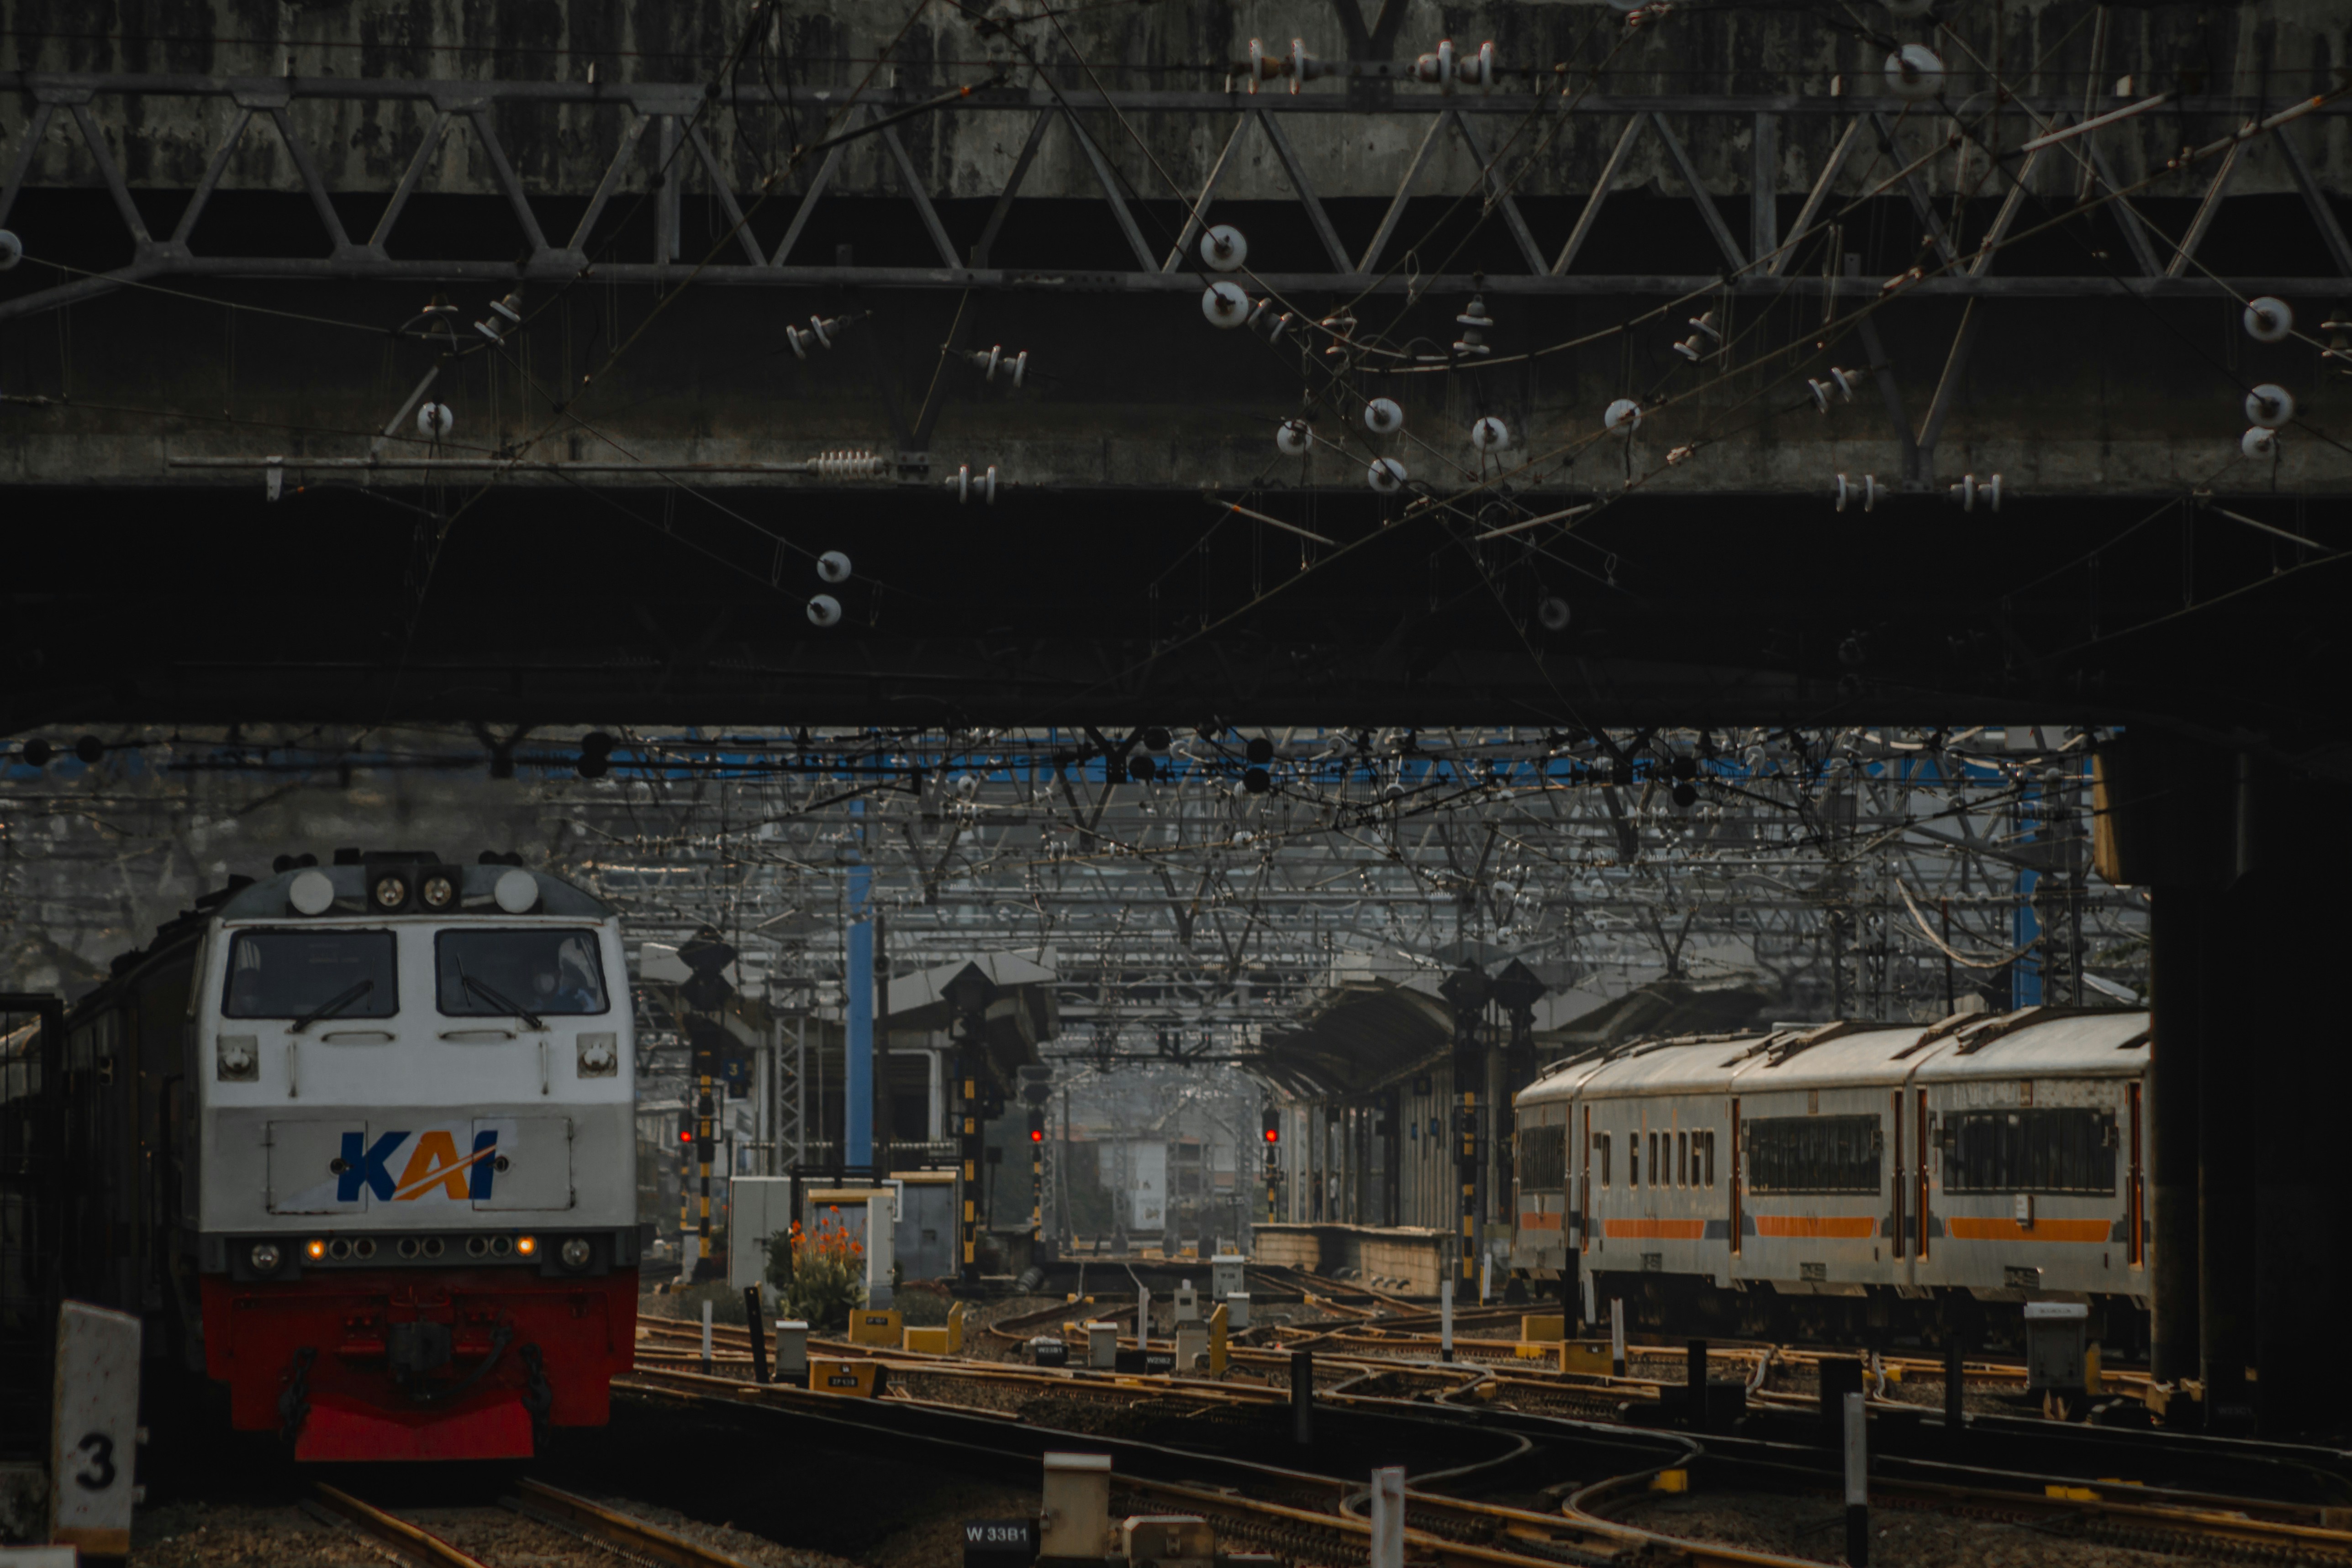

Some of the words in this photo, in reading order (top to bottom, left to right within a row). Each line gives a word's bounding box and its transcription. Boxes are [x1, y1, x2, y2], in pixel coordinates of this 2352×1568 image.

[728, 1062, 739, 1077] 3
[337, 1130, 498, 1202] KAI
[76, 1432, 115, 1490] 3
[966, 1526, 983, 1542] W
[986, 1526, 1027, 1542] 33B1
